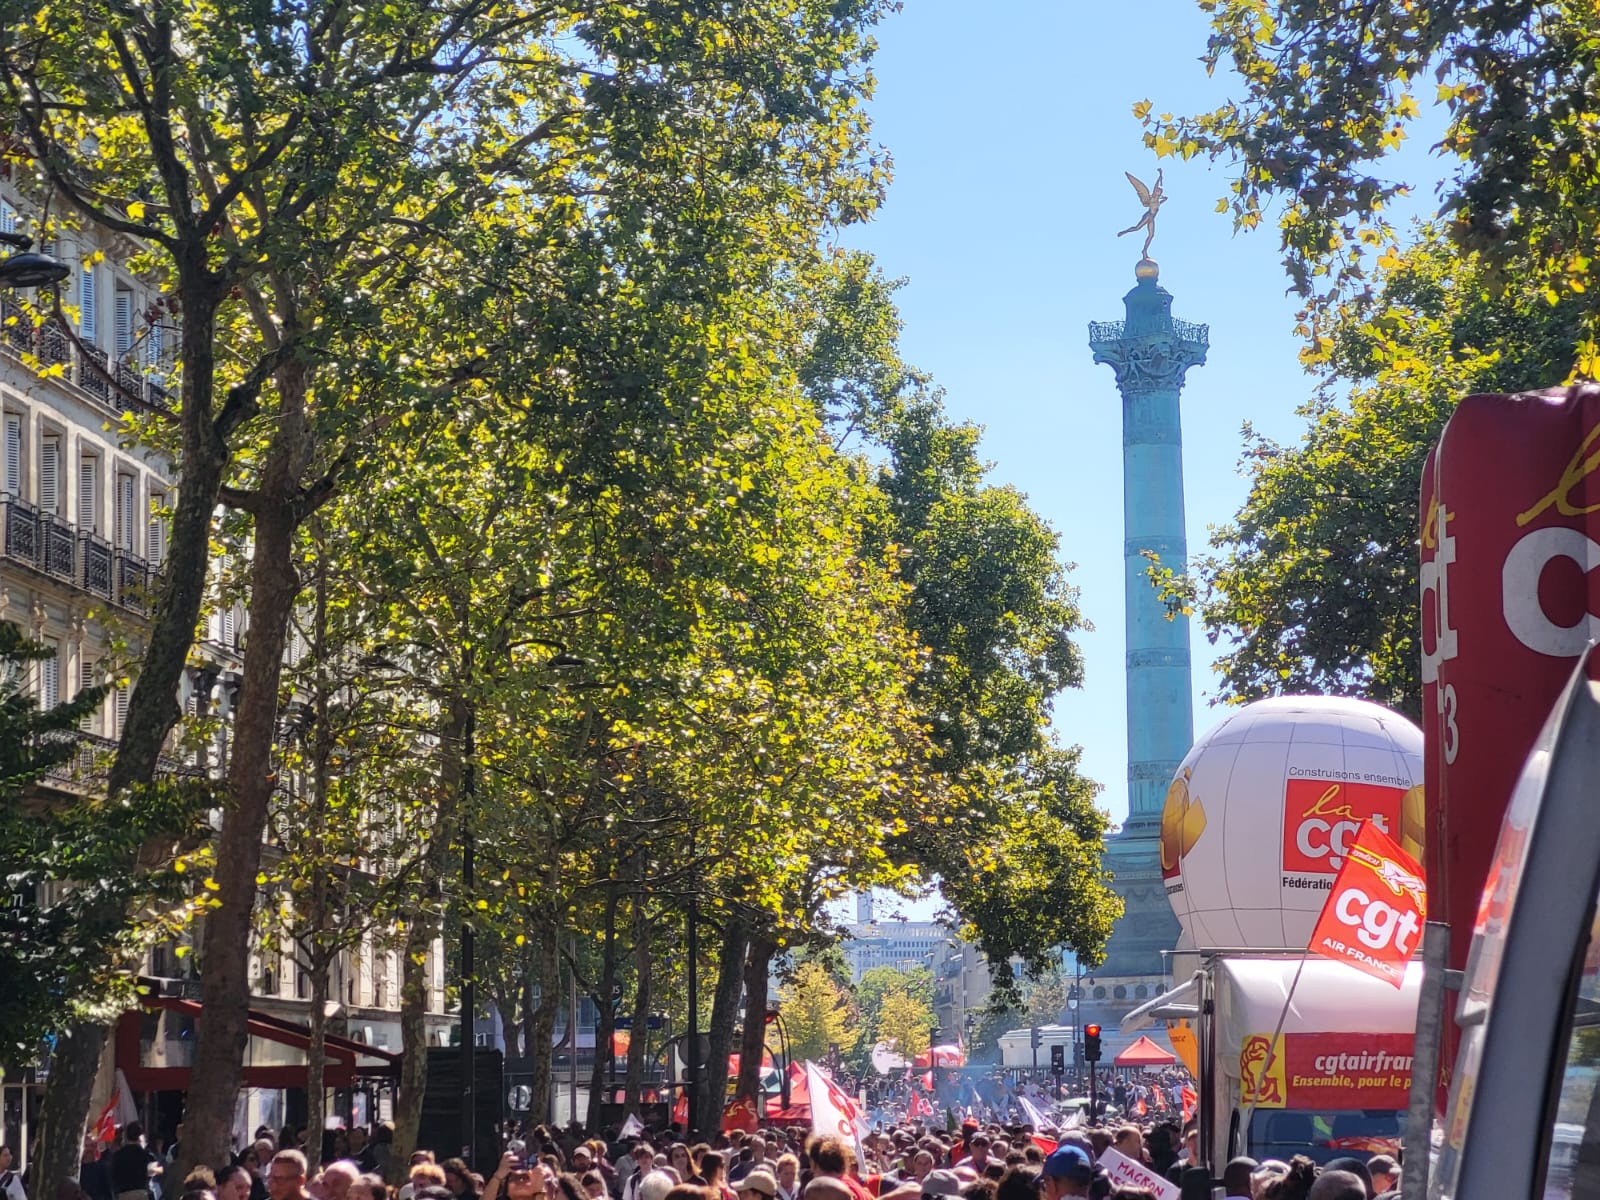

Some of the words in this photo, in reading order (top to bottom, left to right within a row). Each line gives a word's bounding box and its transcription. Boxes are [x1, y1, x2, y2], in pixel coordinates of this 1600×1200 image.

[1288, 766, 1361, 780] Construisons
[1363, 773, 1411, 787] ensemble
[1302, 783, 1366, 821] la
[1282, 876, 1334, 890] Fédératio
[1335, 888, 1419, 955] cgt
[1322, 937, 1345, 954] AIR
[1346, 949, 1401, 978] FRANCE
[1292, 1074, 1354, 1089] Ensemble,
[1357, 1077, 1387, 1090] pour
[1389, 1074, 1401, 1087] le
[1117, 1161, 1165, 1197] MACRON
